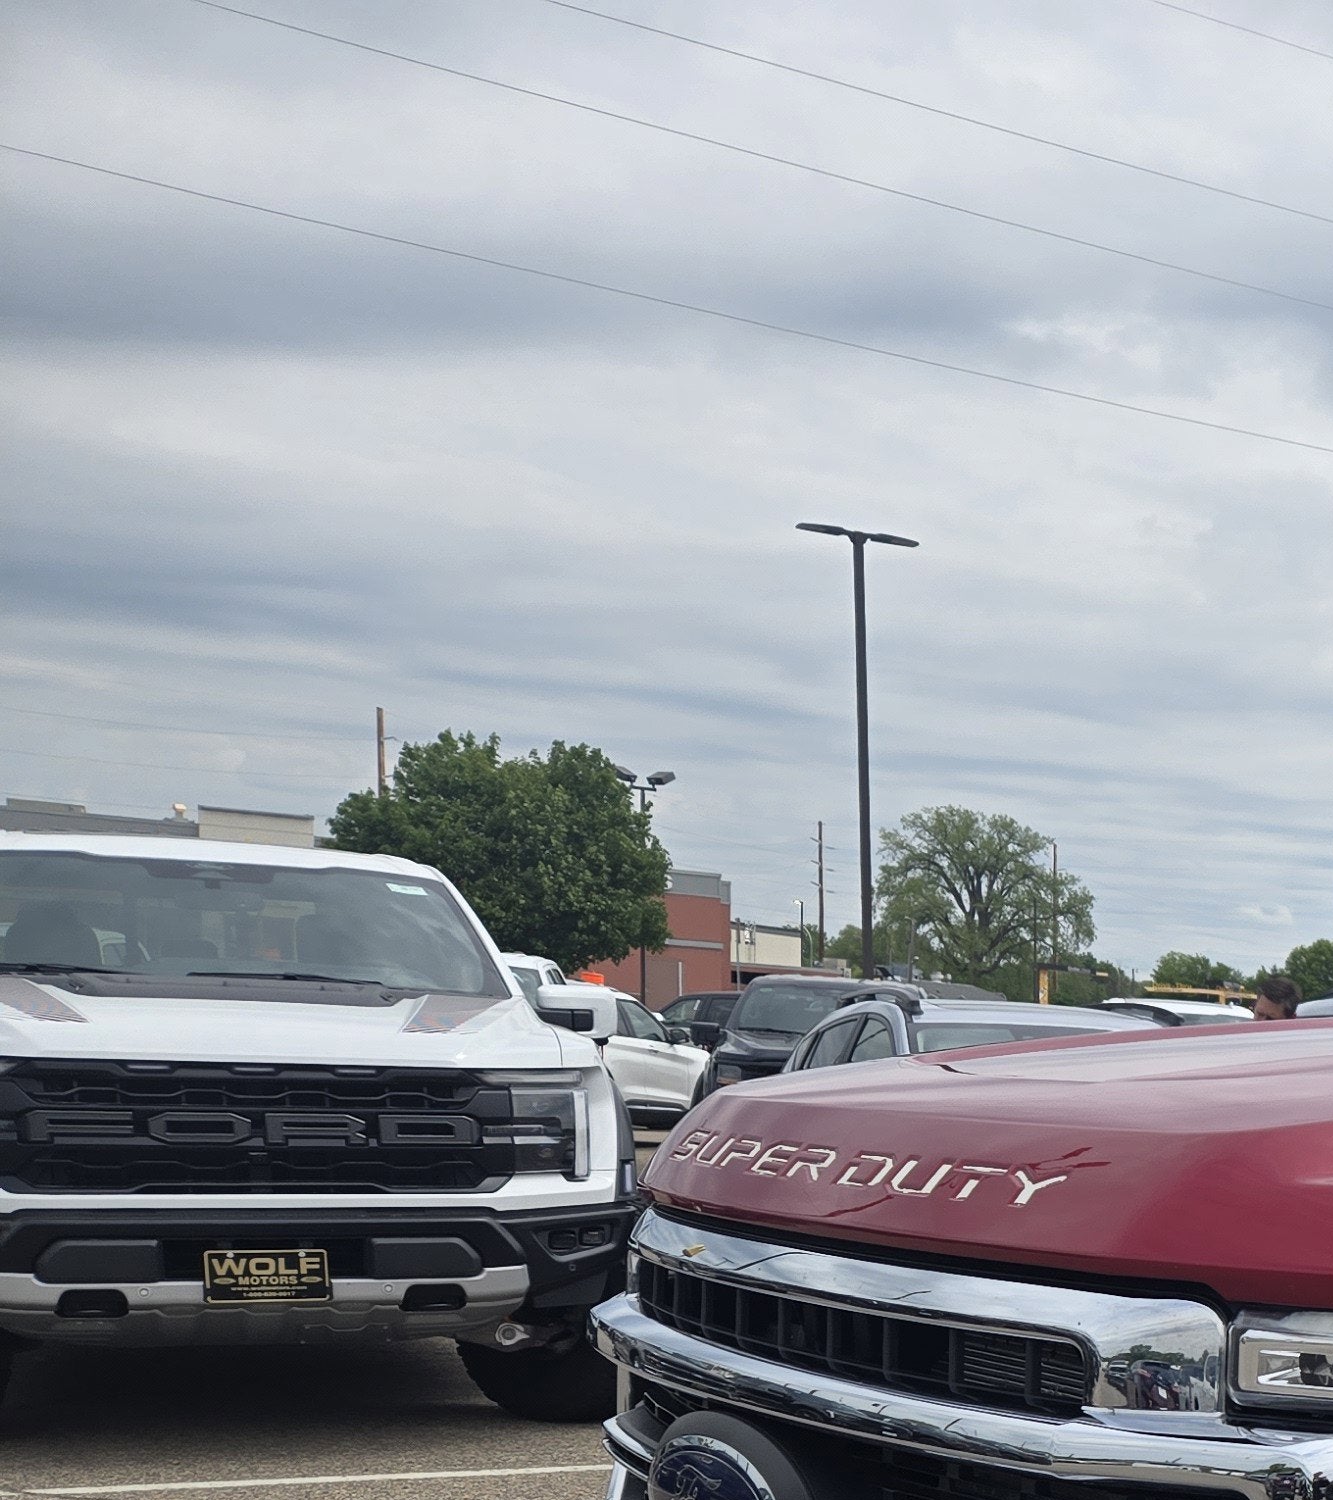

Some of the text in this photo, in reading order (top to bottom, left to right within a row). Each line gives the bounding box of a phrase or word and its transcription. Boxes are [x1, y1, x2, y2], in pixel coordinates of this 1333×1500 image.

[18, 1109, 483, 1147] FORD
[670, 1129, 1069, 1208] SUPER DUTY
[211, 1257, 321, 1276] WOLF
[237, 1275, 299, 1286] MOTORS
